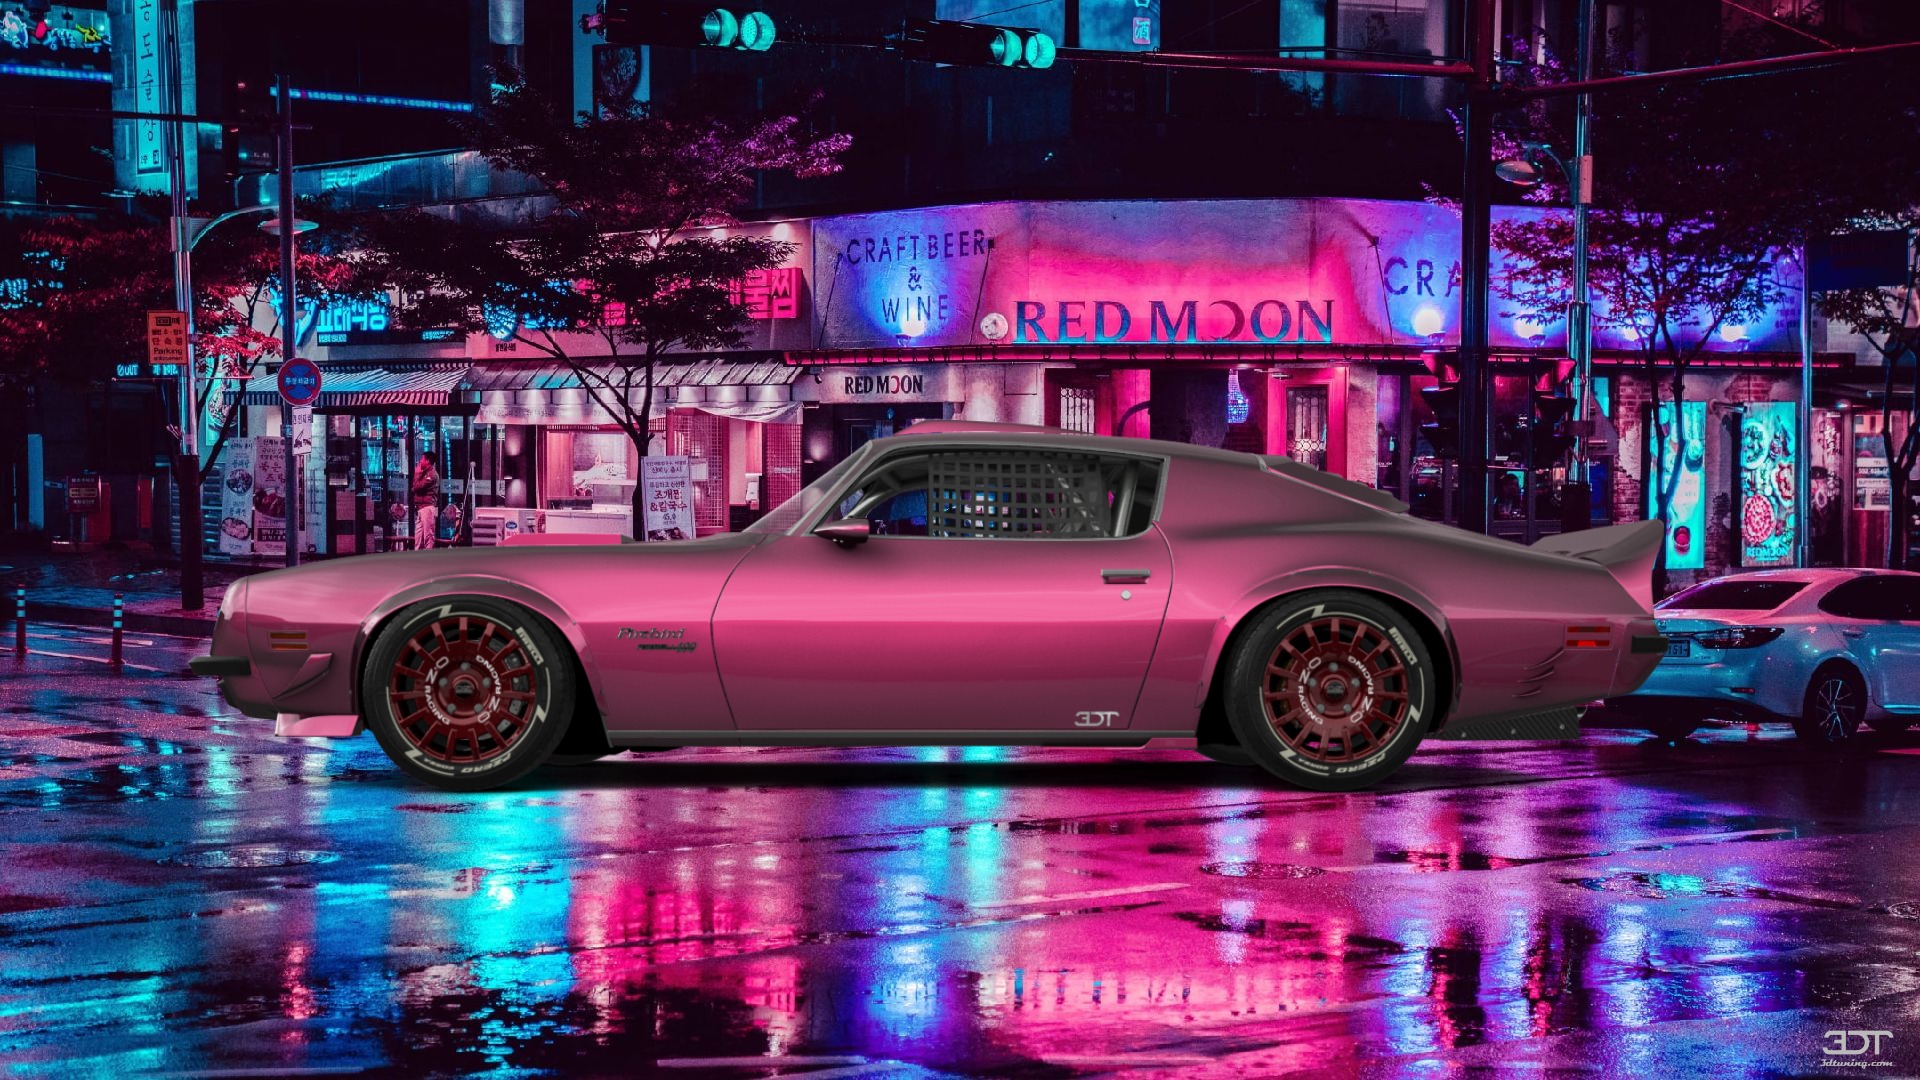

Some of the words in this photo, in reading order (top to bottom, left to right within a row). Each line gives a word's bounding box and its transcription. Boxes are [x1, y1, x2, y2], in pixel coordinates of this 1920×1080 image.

[847, 236, 920, 265] CRAFT
[928, 229, 985, 260] BEER
[908, 266, 922, 291] &
[882, 295, 948, 323] WINE
[1013, 300, 1131, 342] RED
[1149, 300, 1335, 342] MOON
[153, 347, 183, 355] Parking
[845, 376, 873, 394] RED
[877, 375, 924, 394] MOON
[475, 655, 501, 694] RACING
[1347, 656, 1374, 695] RACING
[424, 685, 450, 725] RACING
[1297, 685, 1323, 725] RACING
